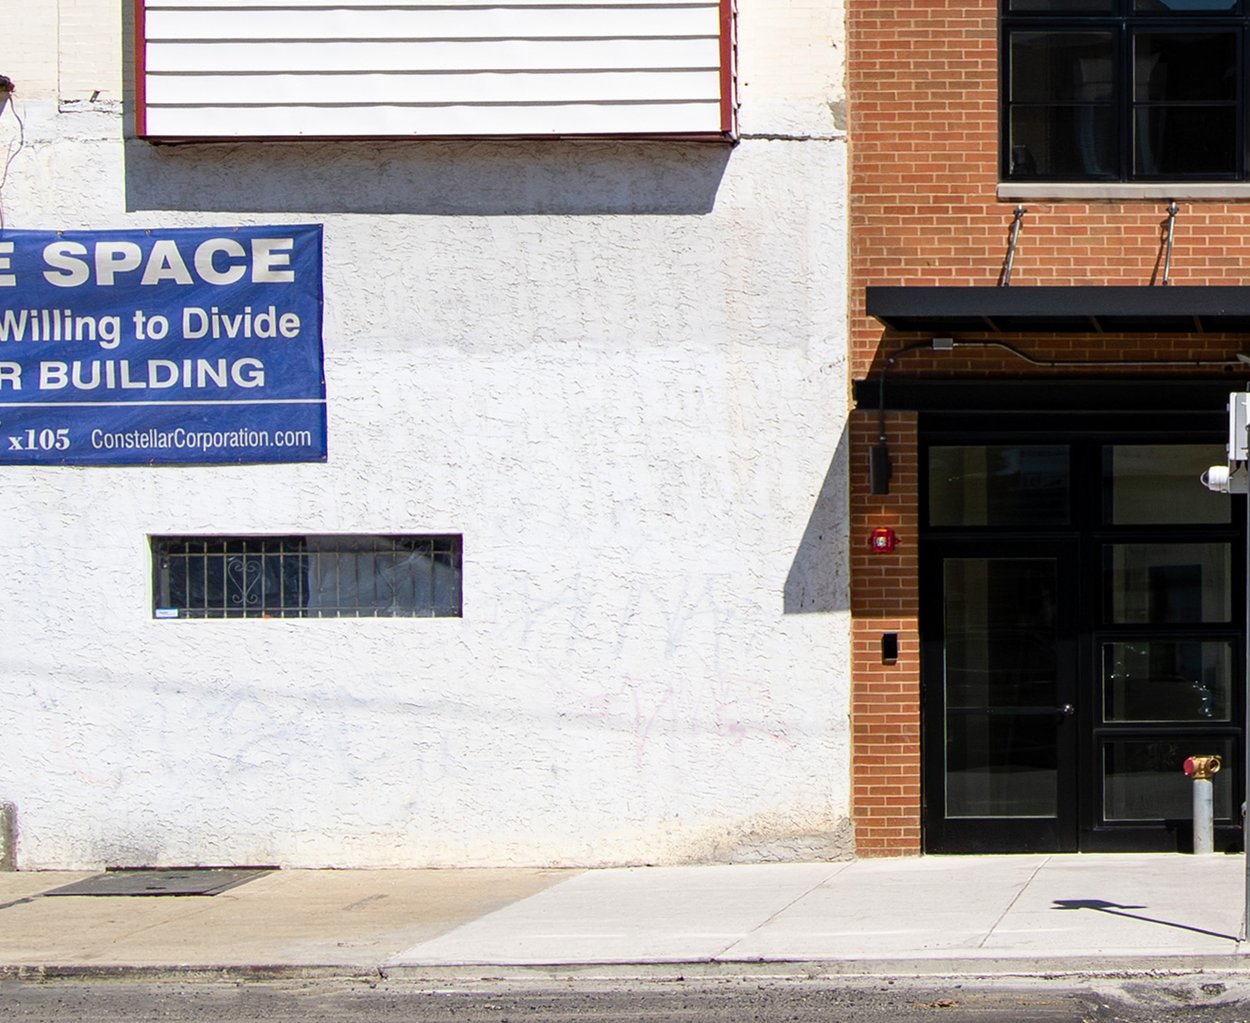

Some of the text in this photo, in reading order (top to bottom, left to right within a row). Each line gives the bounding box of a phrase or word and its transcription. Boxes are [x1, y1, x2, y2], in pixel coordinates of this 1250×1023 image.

[42, 237, 295, 288] SPACE
[0, 305, 301, 350] Willing to Divide
[39, 358, 265, 390] BUILDING
[8, 427, 312, 451] x105 ConstellarCorporation.com
